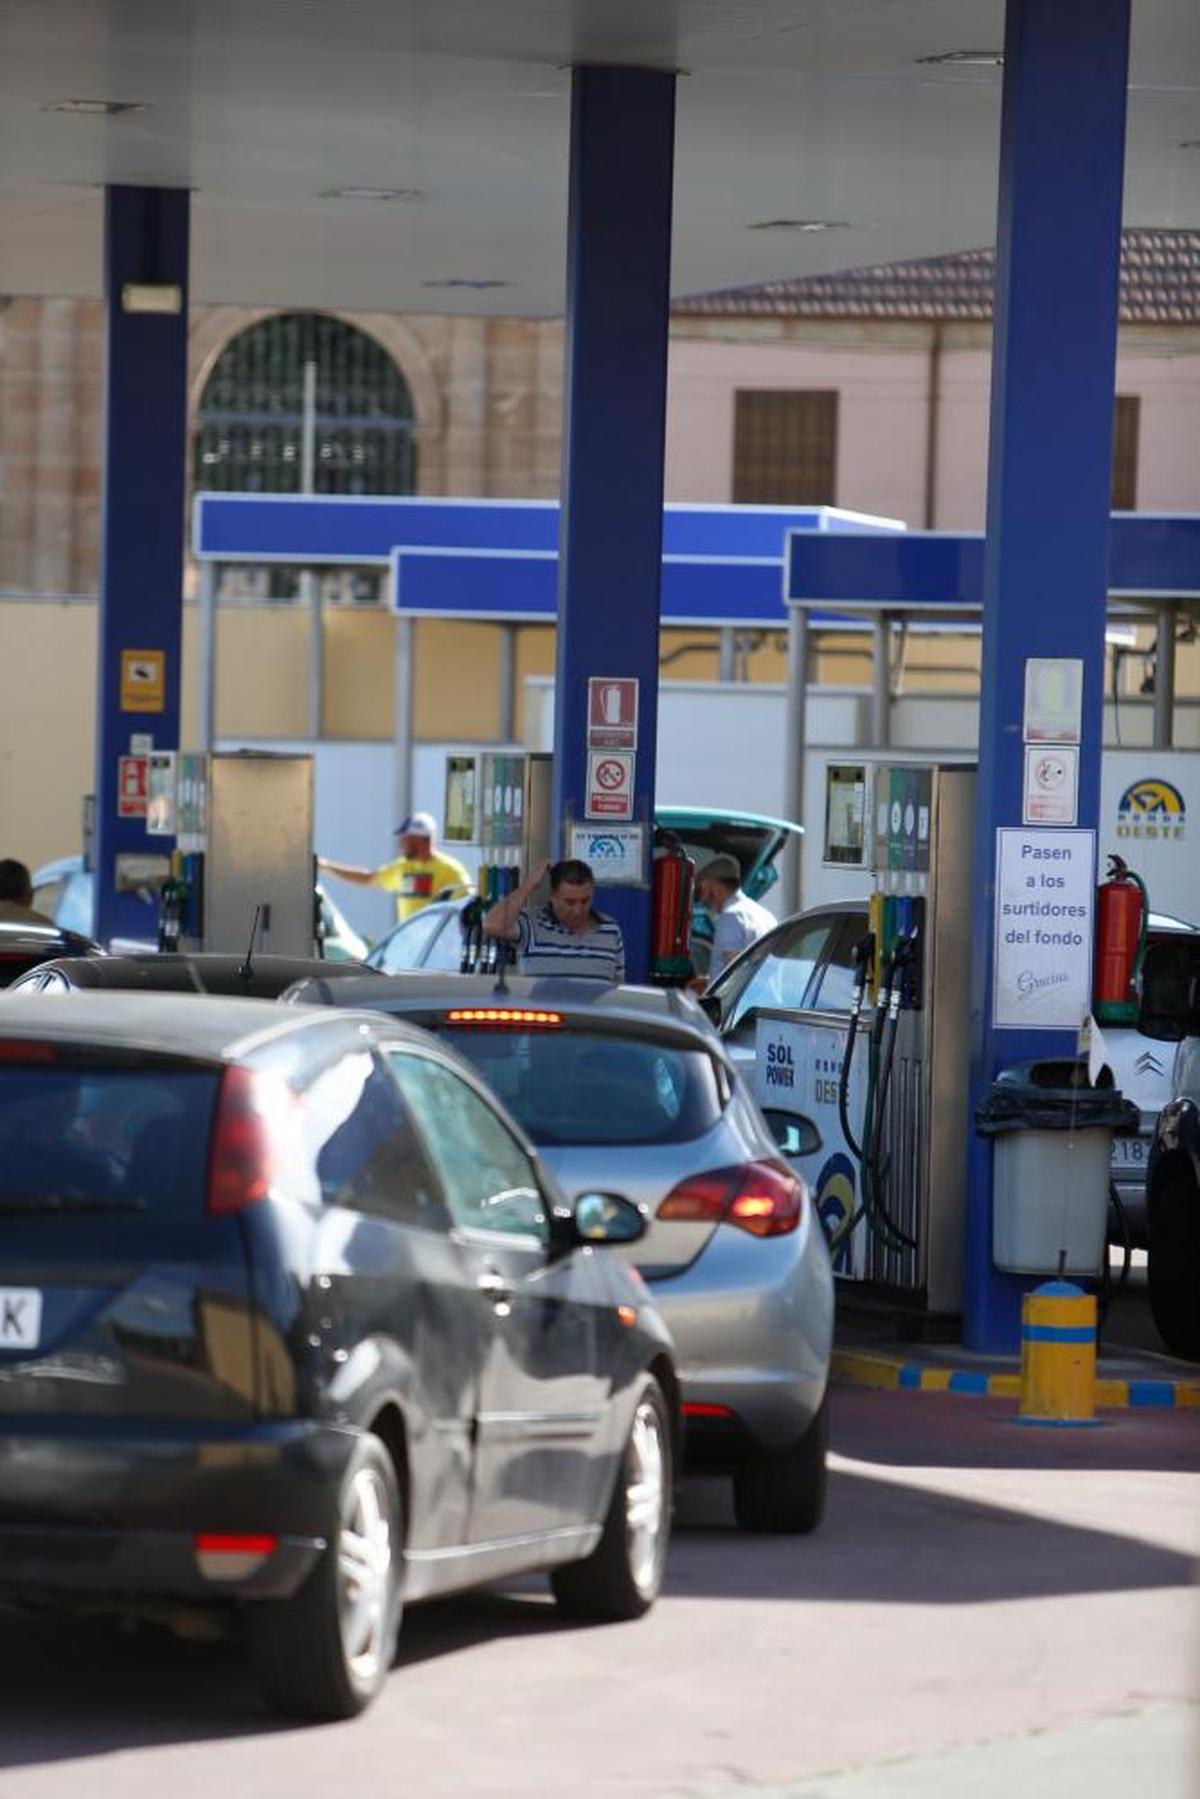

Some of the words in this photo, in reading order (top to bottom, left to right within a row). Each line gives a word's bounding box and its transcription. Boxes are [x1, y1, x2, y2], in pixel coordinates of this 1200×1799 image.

[1021, 845, 1072, 860] Pasen
[1025, 875, 1036, 888] a
[1041, 873, 1065, 888] los
[1002, 902, 1088, 917] surtidores
[1005, 929, 1030, 944] del
[1034, 929, 1083, 945] fondo
[767, 1043, 795, 1065] SOL
[766, 1064, 794, 1088] POWER
[1110, 1141, 1149, 1160] 218
[2, 1297, 26, 1339] K
